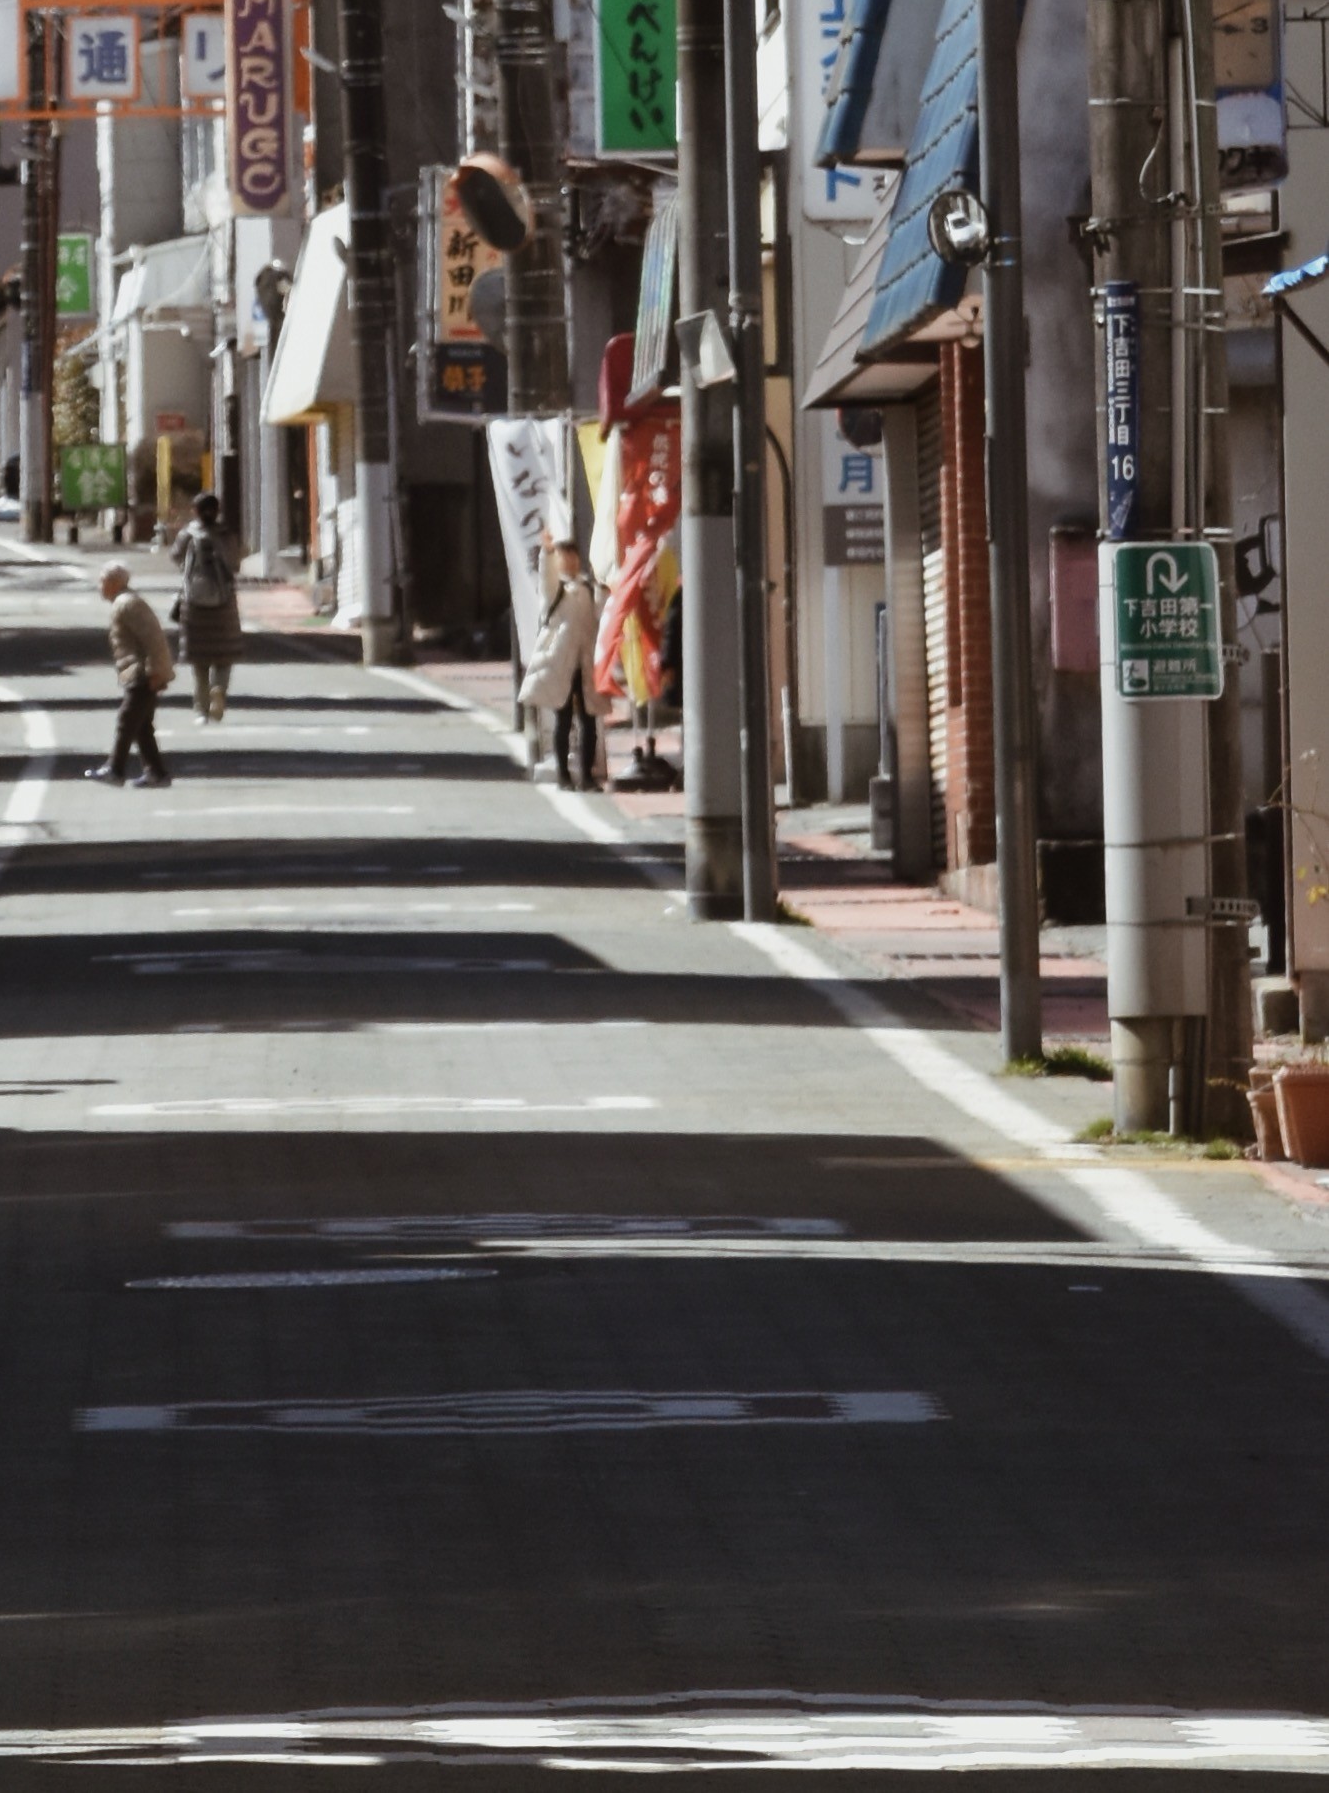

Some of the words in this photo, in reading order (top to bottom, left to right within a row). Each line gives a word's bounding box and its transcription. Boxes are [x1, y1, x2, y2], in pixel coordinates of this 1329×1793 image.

[1113, 314, 1132, 445] 下吉田三丁目
[1111, 454, 1135, 481] 16
[1123, 597, 1214, 618] 下吉田第一
[1140, 618, 1199, 639] 小学校
